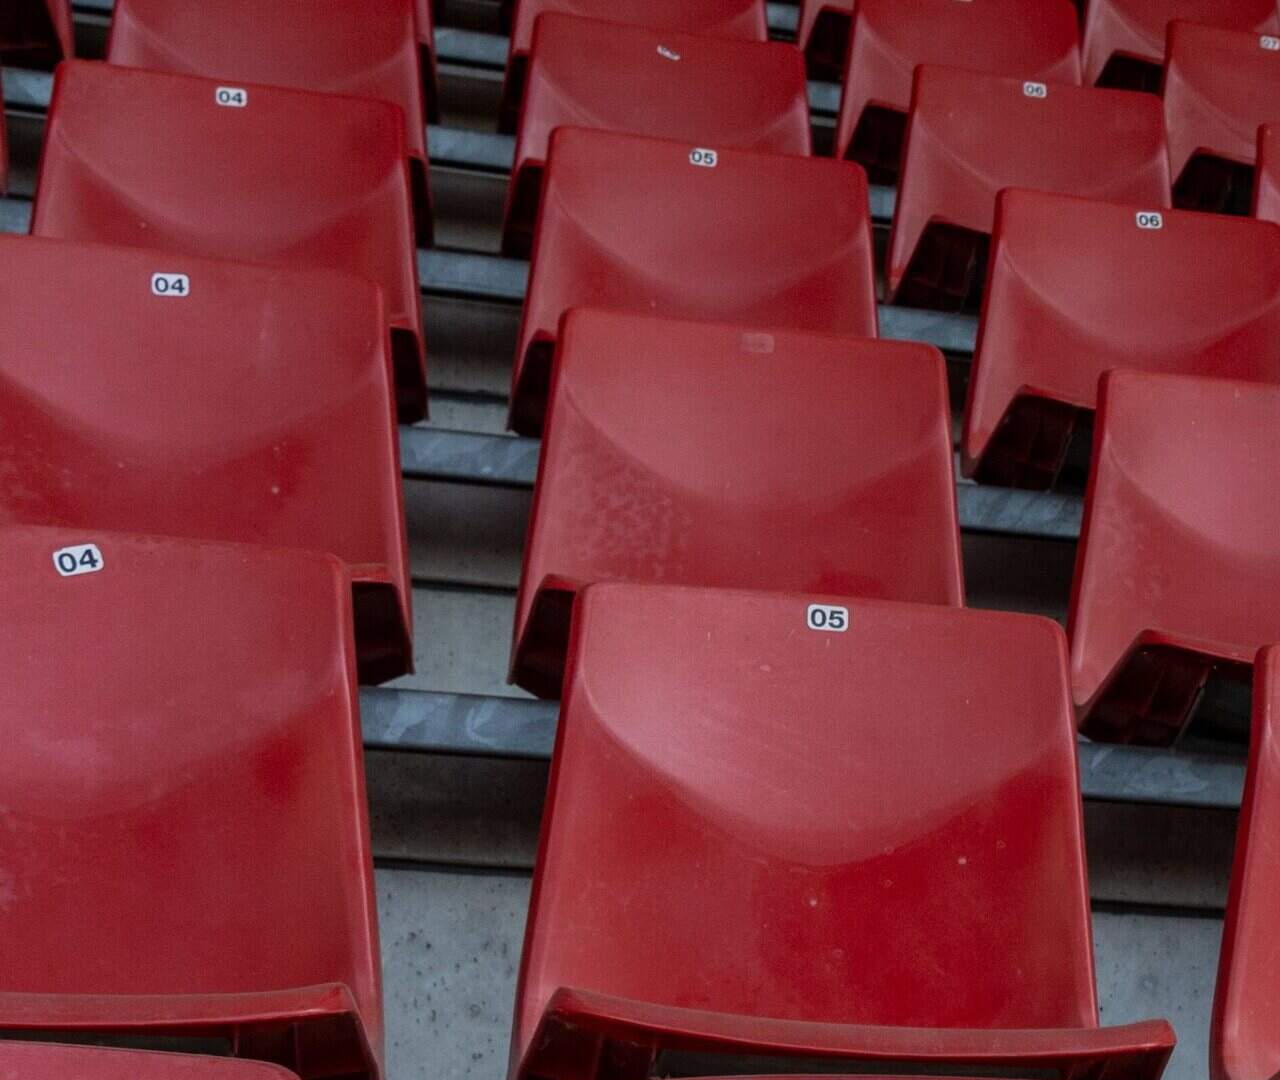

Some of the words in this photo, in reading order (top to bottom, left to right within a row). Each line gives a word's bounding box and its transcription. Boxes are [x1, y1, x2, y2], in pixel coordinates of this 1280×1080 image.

[218, 90, 243, 105] 04
[1026, 84, 1043, 96] 06
[692, 151, 715, 165] 05
[1139, 215, 1159, 227] 06
[155, 277, 185, 293] 04
[58, 549, 98, 573] 04
[811, 608, 845, 630] 05
